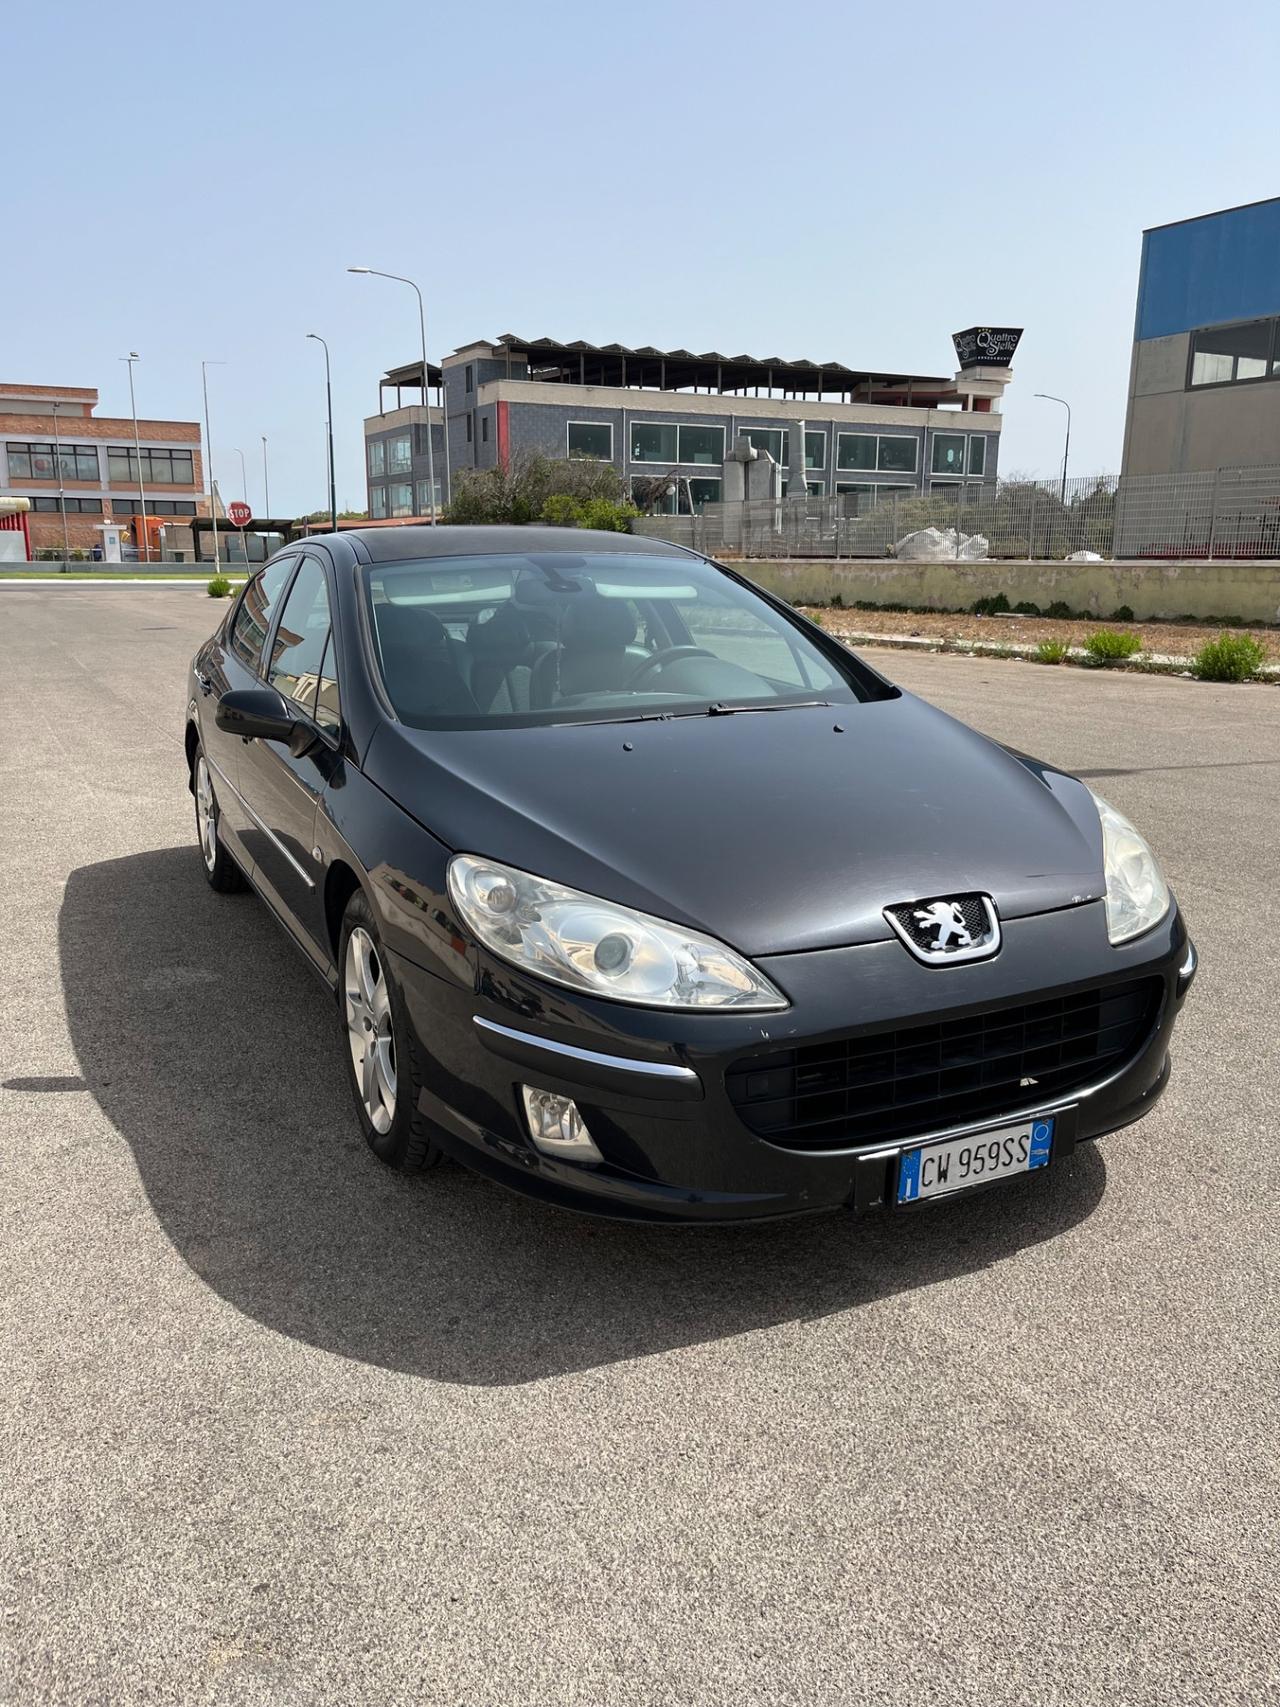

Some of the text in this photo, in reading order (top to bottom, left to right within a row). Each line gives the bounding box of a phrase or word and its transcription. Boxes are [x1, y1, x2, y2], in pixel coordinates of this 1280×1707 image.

[977, 332, 1018, 347] Quattro
[986, 341, 1016, 356] Stelle
[229, 508, 250, 519] STOP
[921, 1133, 1030, 1187] CW 959SS
